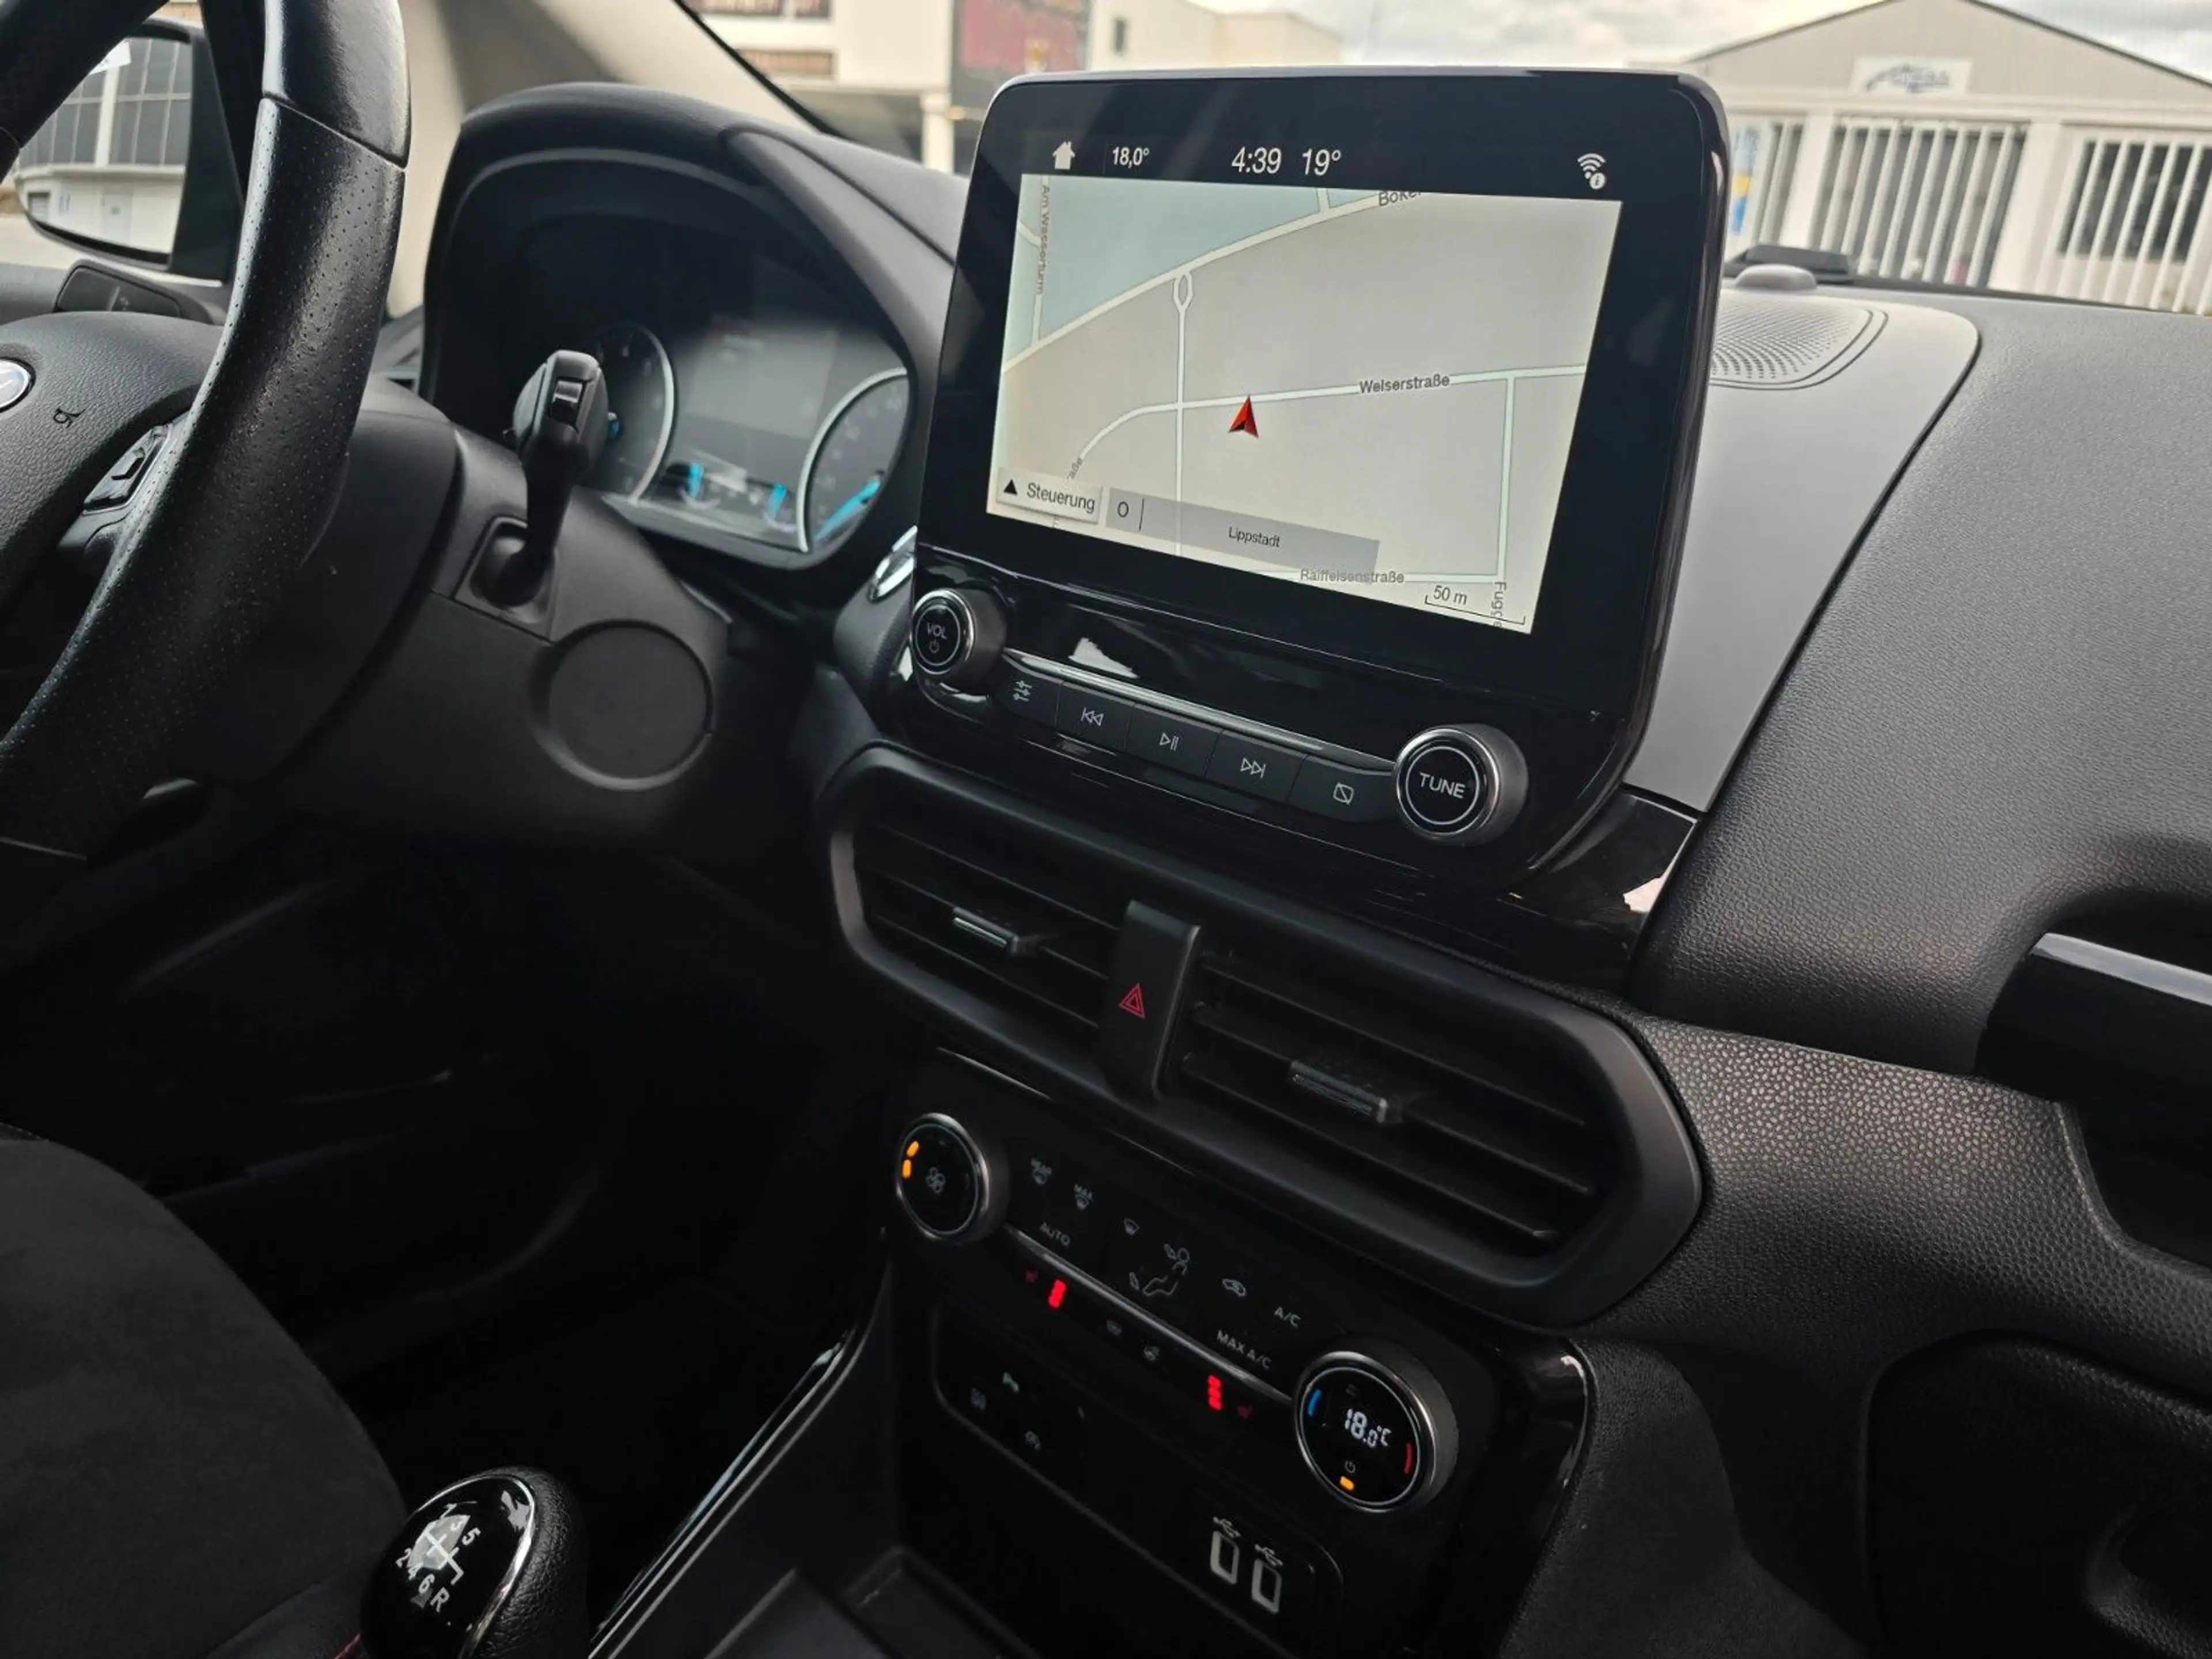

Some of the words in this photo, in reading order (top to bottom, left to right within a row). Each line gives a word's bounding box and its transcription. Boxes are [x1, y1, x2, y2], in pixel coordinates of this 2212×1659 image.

[1112, 146, 1150, 169] 18,0°
[1230, 146, 1282, 174] 4:39
[1301, 149, 1342, 176] 19°
[1027, 482, 1095, 514] Steuerung
[1229, 526, 1280, 548] Lippstadt
[1433, 584, 1452, 601] 50
[1453, 592, 1468, 605] m
[1419, 772, 1465, 800] TUNE
[1039, 1221, 1071, 1247] AUTO
[1274, 1306, 1302, 1328] A/C
[1217, 1330, 1245, 1354] MAX
[1247, 1349, 1272, 1370] A/C
[462, 1527, 480, 1546] 5
[396, 1548, 411, 1569] 2
[419, 1573, 435, 1593] 6
[430, 1587, 449, 1612] R
